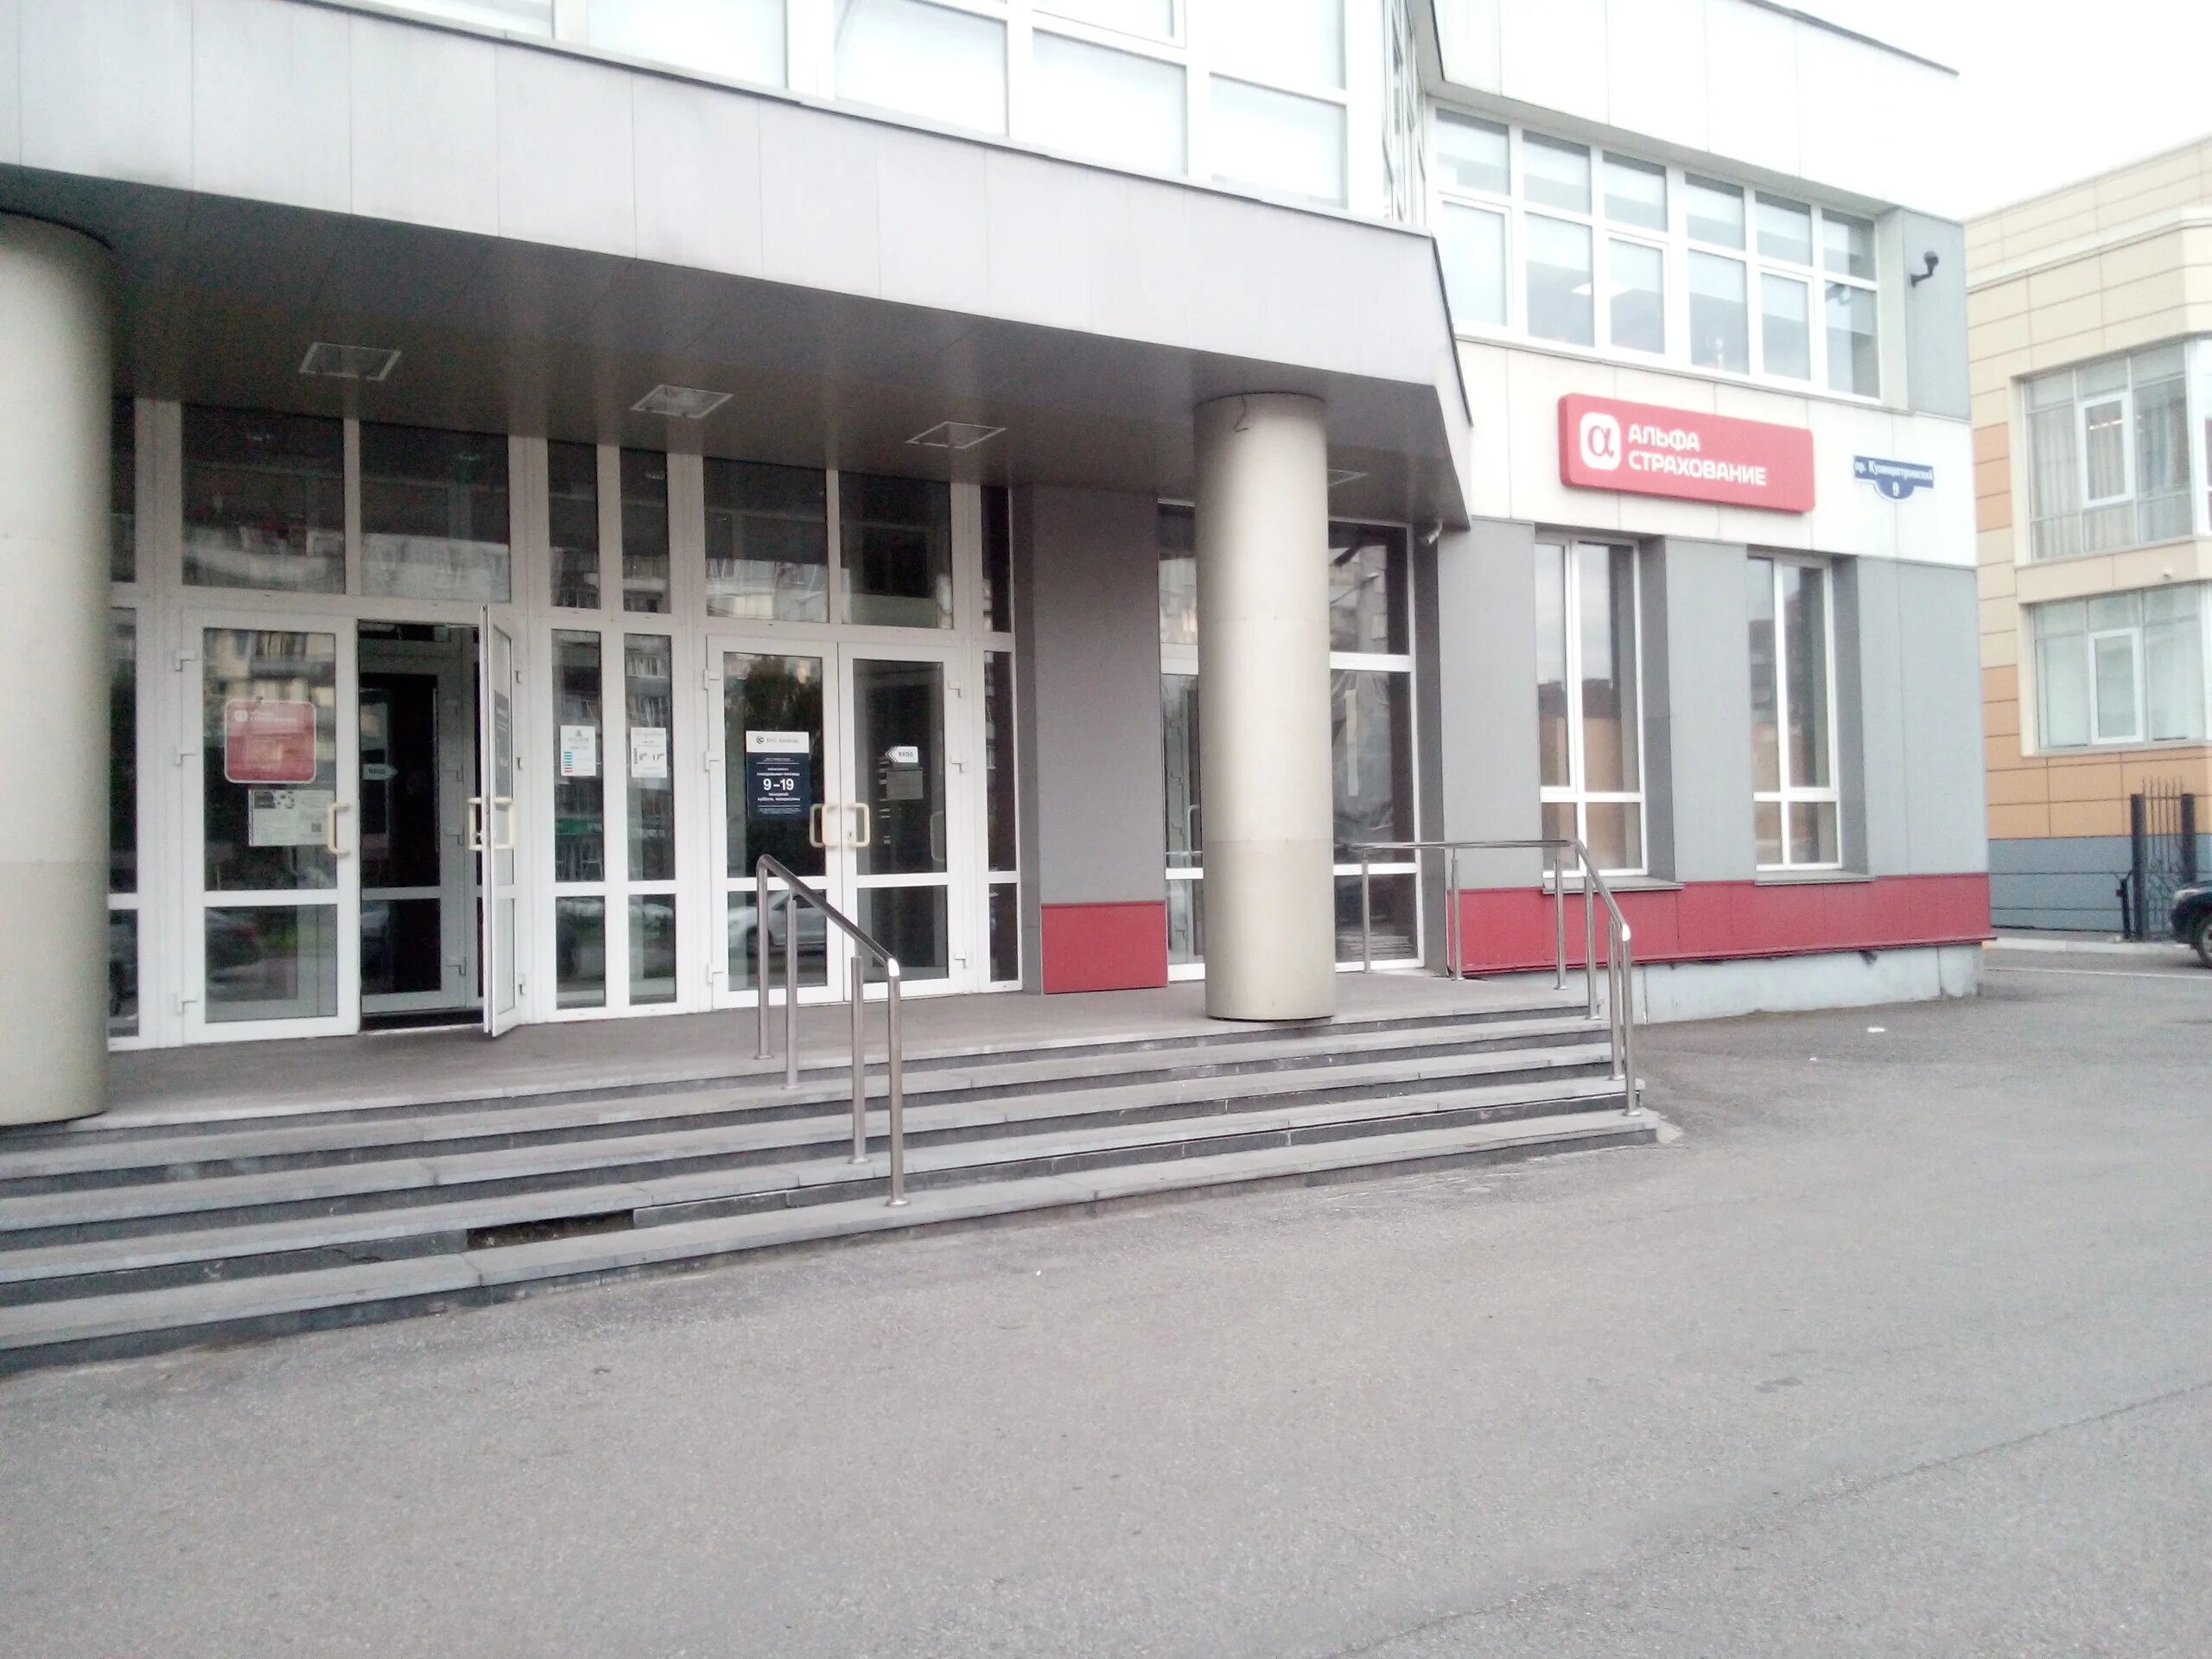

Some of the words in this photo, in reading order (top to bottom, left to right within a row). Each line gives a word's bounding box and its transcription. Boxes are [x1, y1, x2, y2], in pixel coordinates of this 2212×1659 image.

[1628, 423, 1700, 453] АЛЬФА
[1628, 450, 1767, 486] СТРАХОВАНИЕ
[1892, 481, 1900, 498] 9
